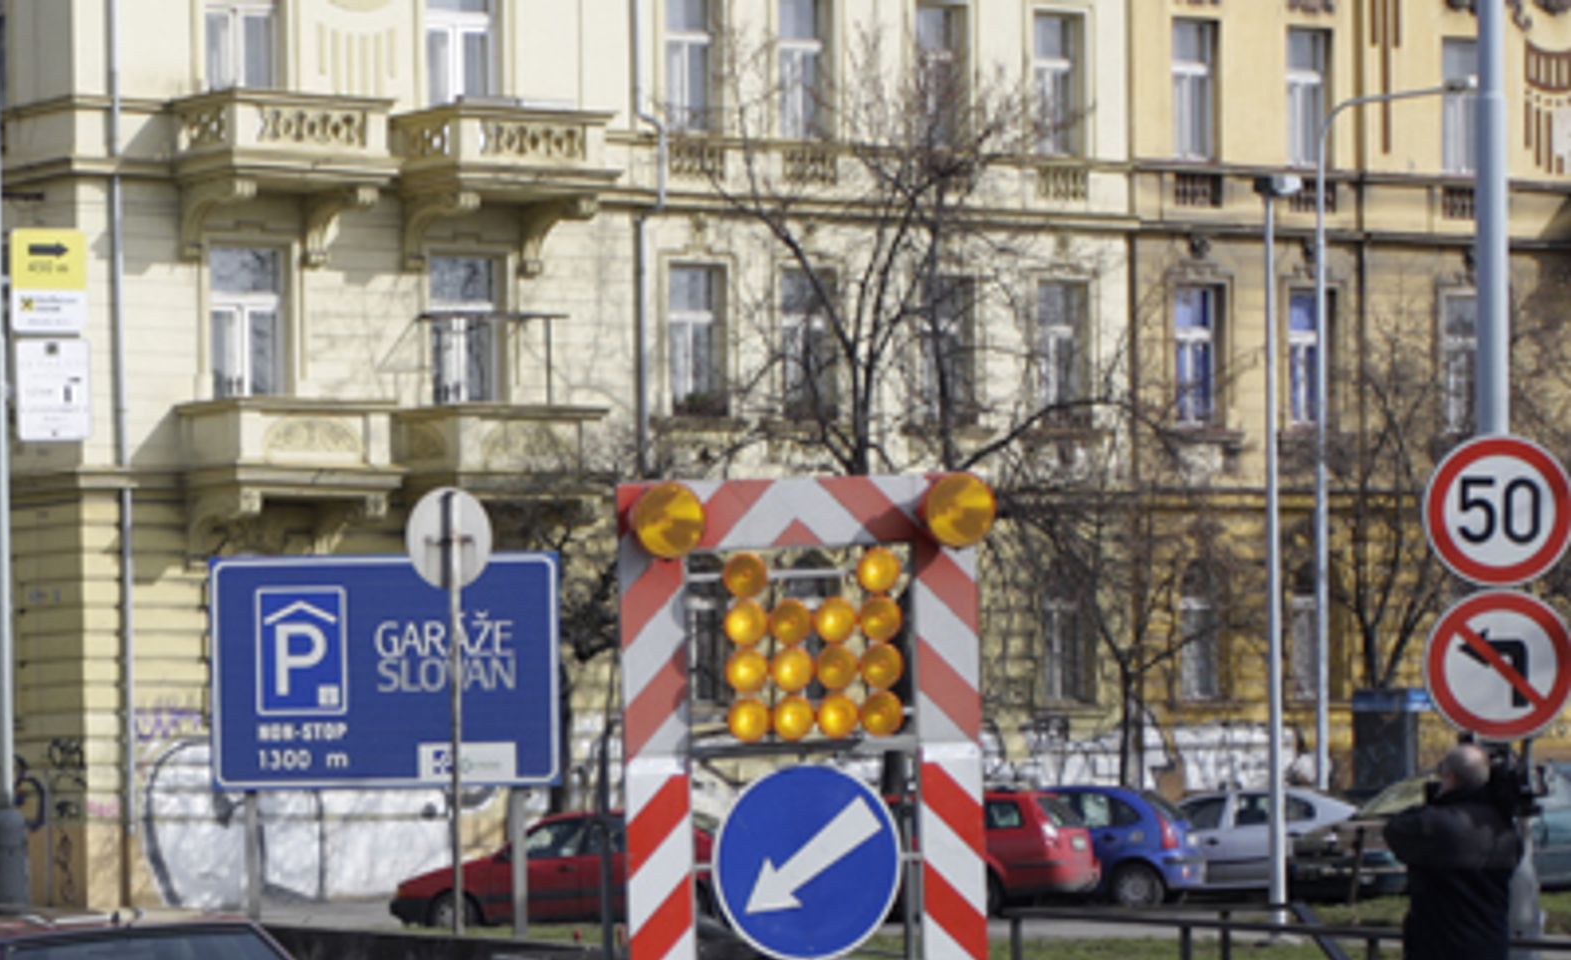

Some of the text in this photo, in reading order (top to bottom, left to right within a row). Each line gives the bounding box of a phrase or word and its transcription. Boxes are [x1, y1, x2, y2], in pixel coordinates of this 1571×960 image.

[1458, 475, 1541, 544] 50
[374, 610, 514, 657] GARÁŽE
[275, 623, 327, 696] P
[257, 722, 348, 741] NON-STOP
[258, 750, 349, 770] 1300 m
